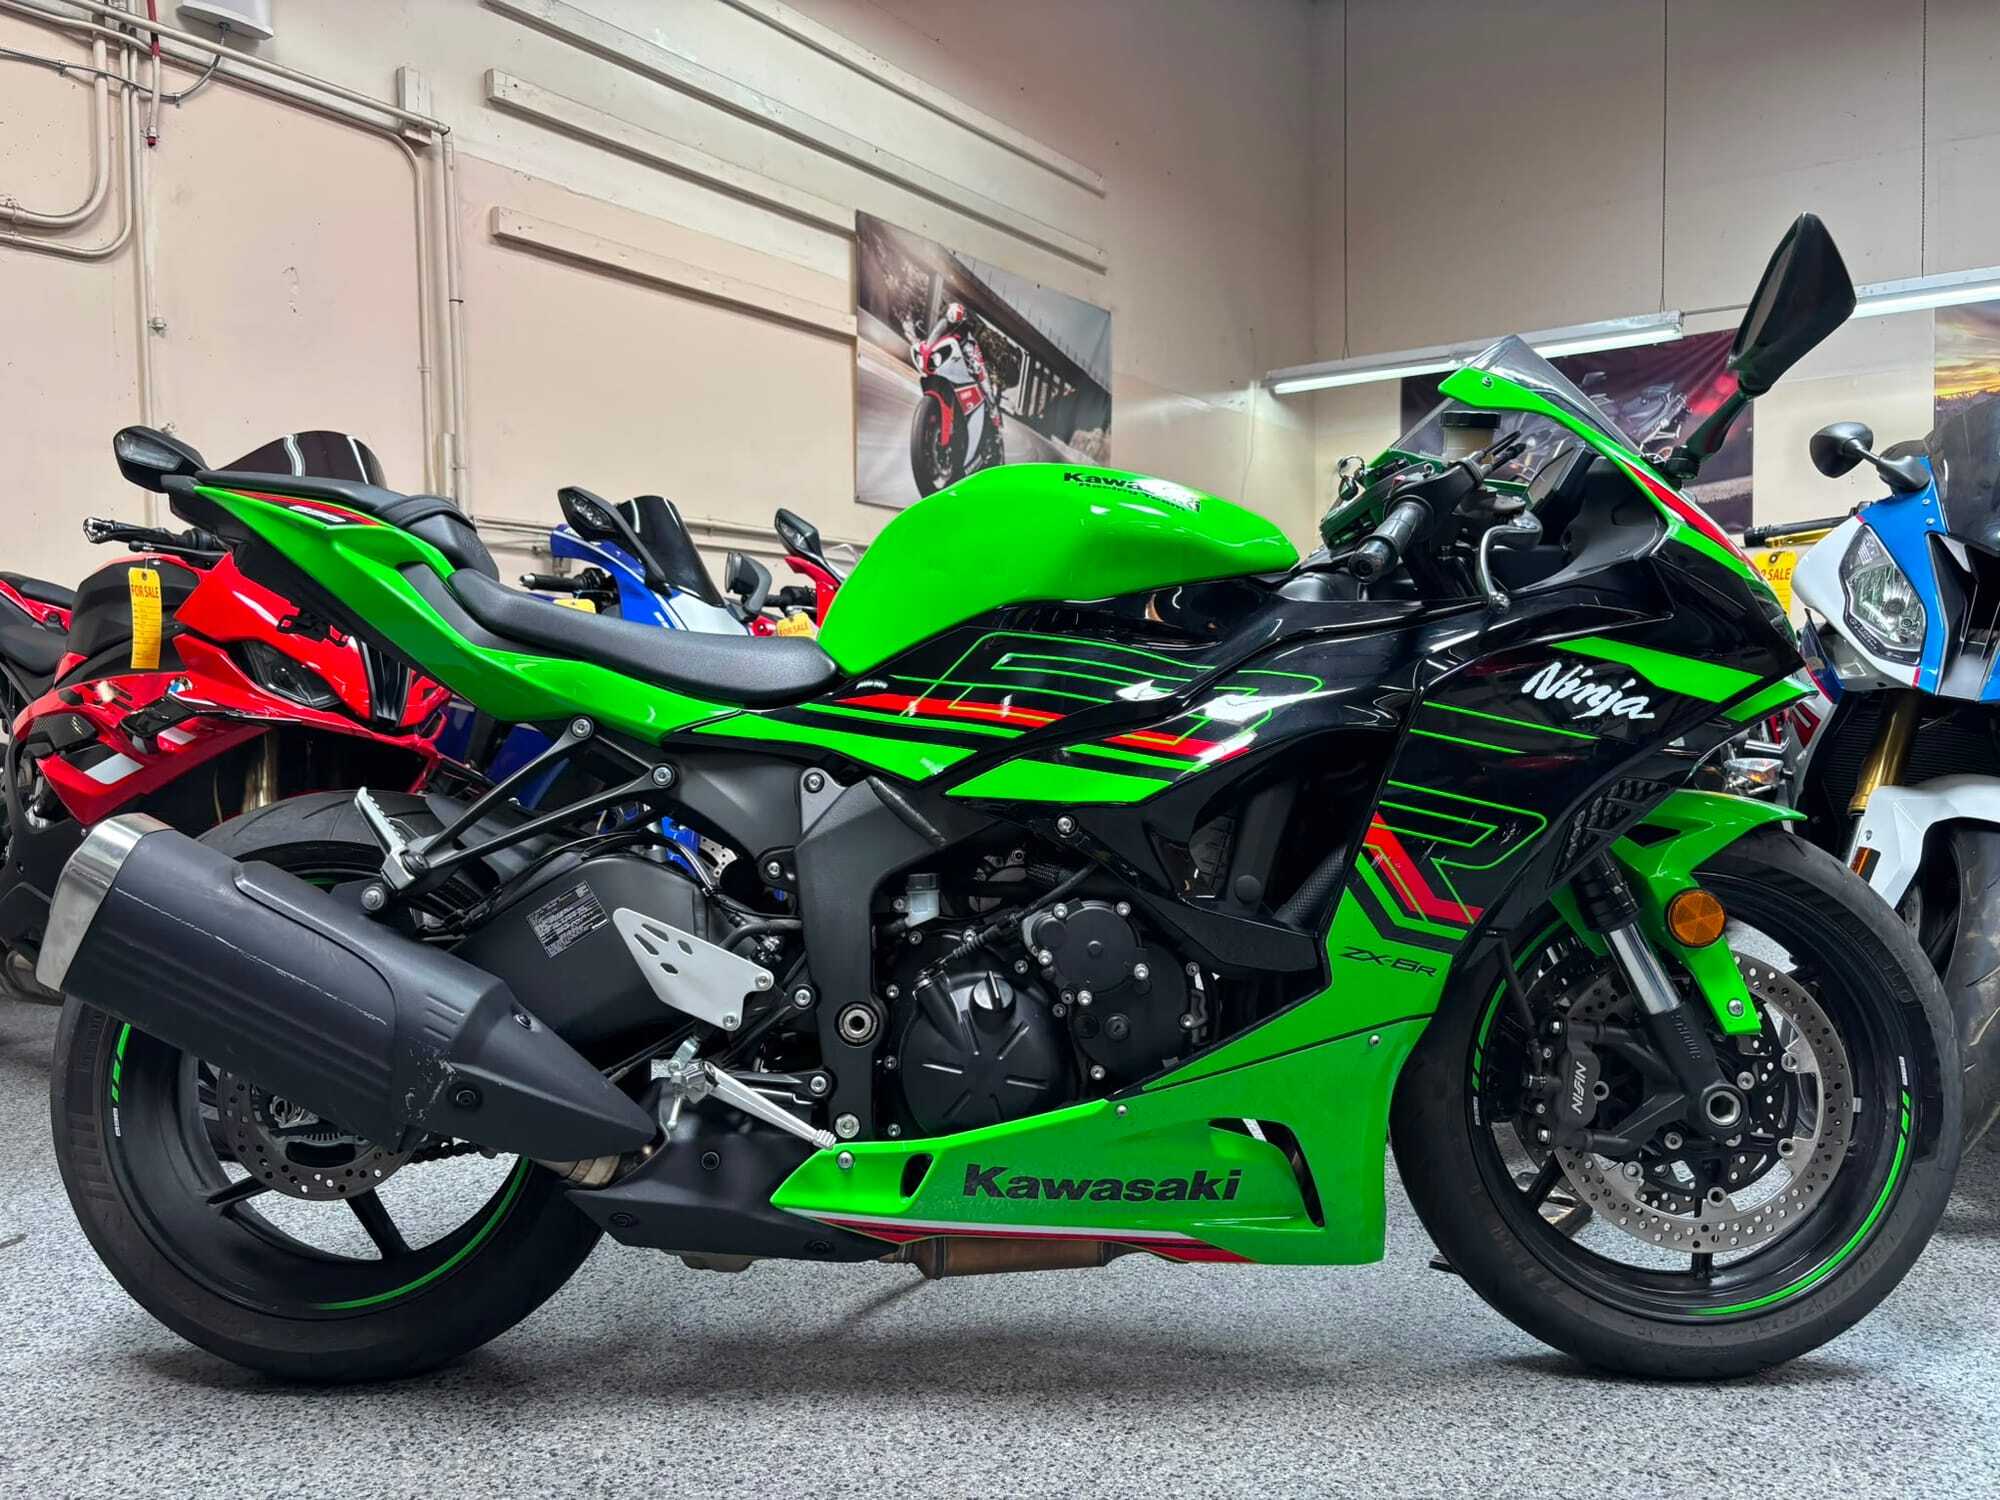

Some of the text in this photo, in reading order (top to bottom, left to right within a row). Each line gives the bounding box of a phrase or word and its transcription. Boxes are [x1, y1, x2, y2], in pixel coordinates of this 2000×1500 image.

[1063, 472, 1201, 513] Kawai
[130, 584, 160, 599] FOR SALE
[1767, 567, 1792, 581] SALE
[793, 621, 809, 633] SALE
[1521, 661, 1656, 720] Ninja
[1340, 945, 1438, 977] ZX-6R
[1570, 1060, 1588, 1115] NISSIN
[962, 1163, 1242, 1202] Kawasaki
